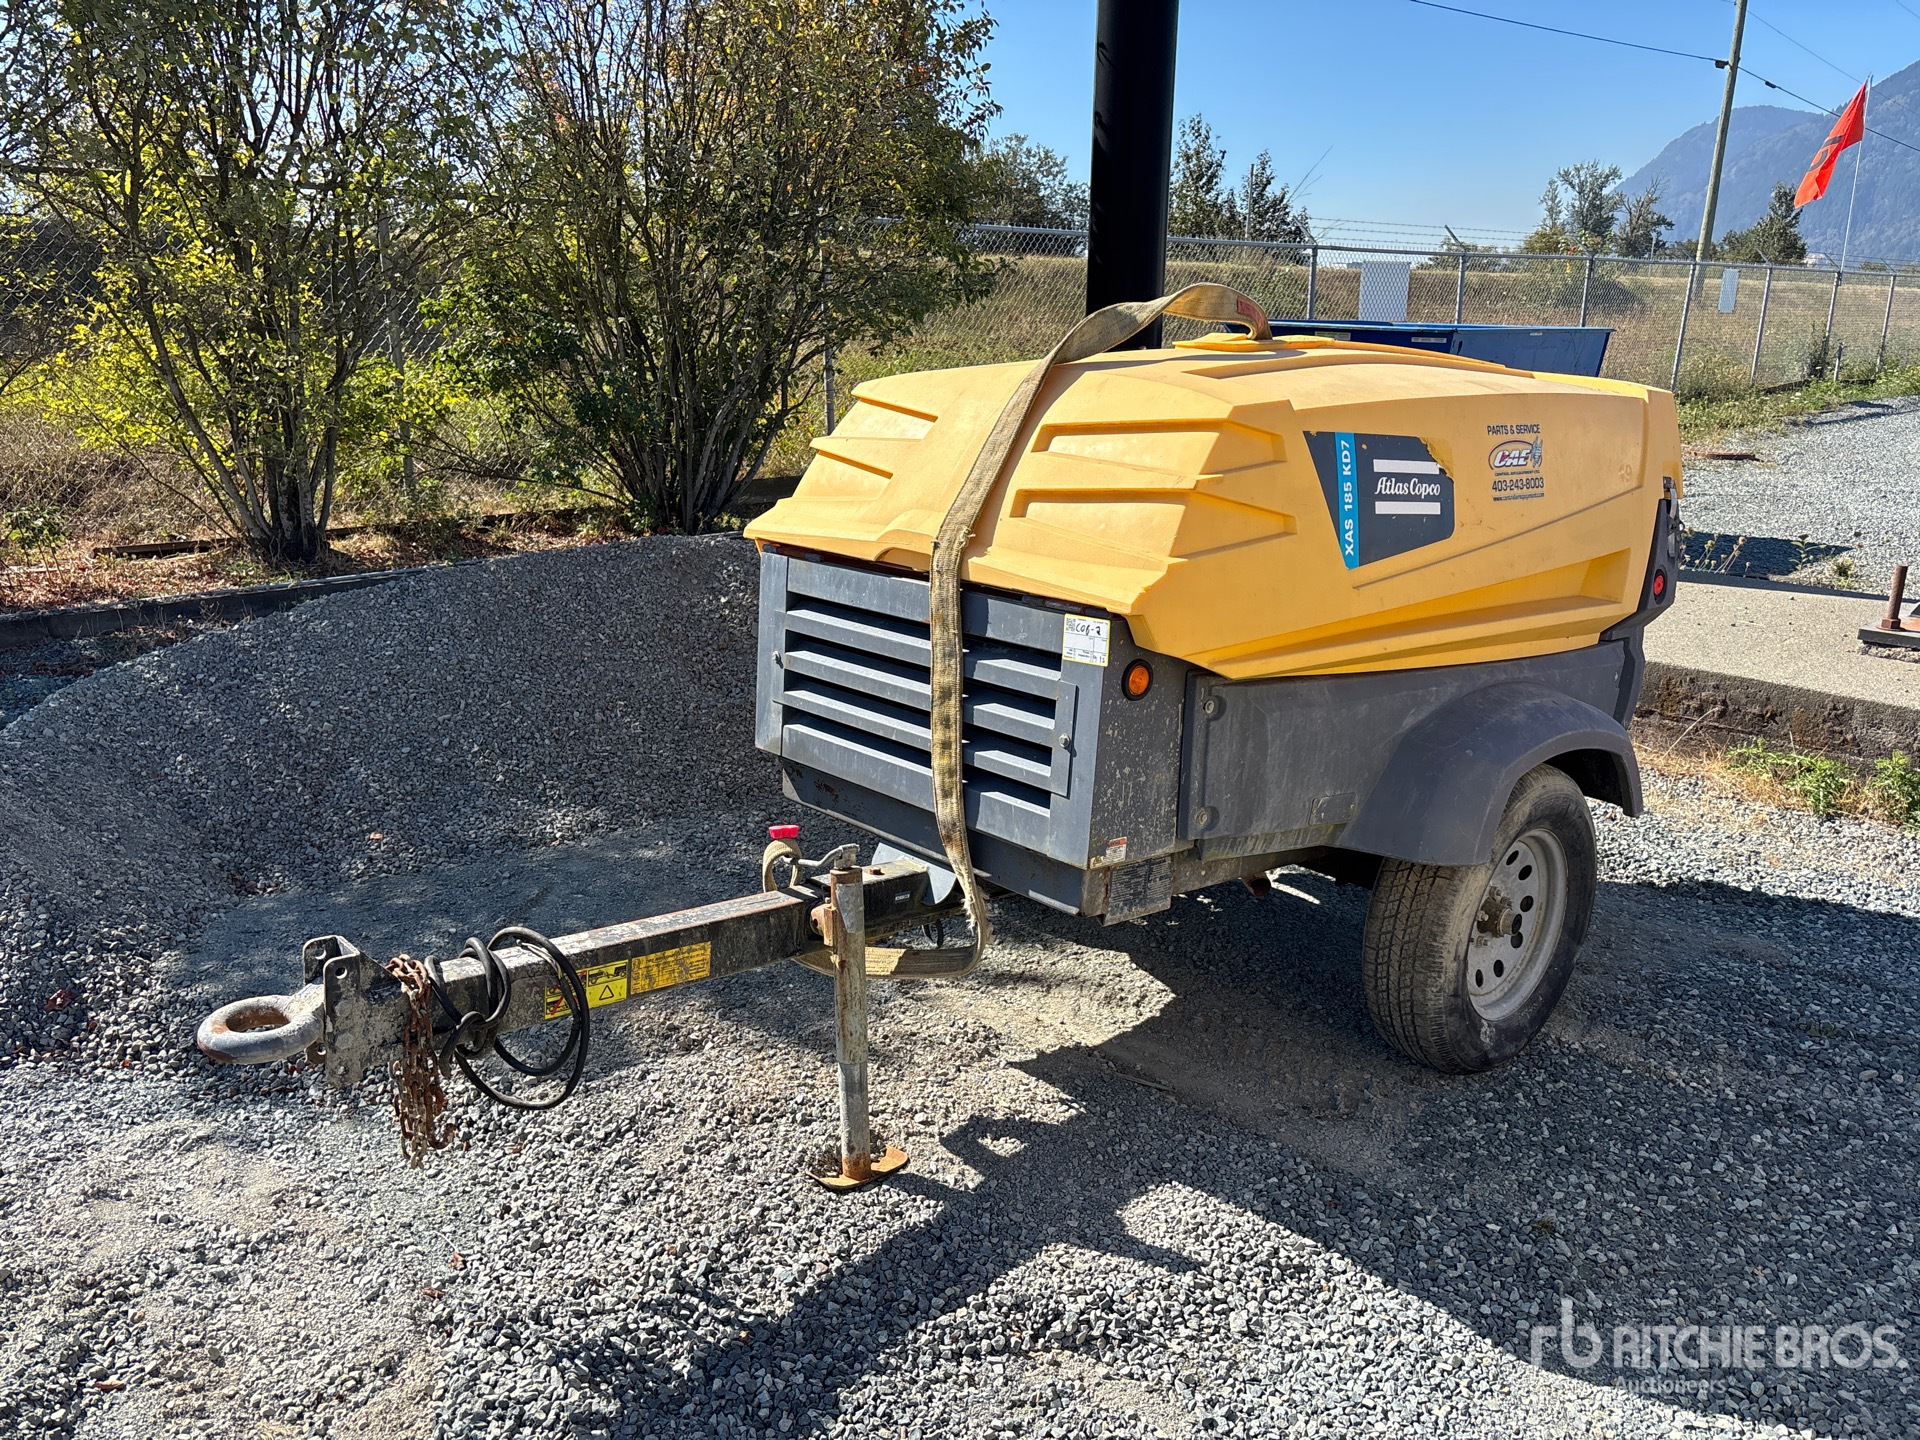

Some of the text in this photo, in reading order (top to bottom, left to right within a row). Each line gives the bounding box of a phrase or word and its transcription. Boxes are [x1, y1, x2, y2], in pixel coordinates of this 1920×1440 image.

[1487, 424, 1541, 435] PARTS & SERVICE
[1494, 449, 1531, 468] CAE
[1375, 477, 1440, 499] Atlas Copco
[1492, 477, 1544, 492] 403-243-8003
[1340, 439, 1354, 556] XAS 185 KD7
